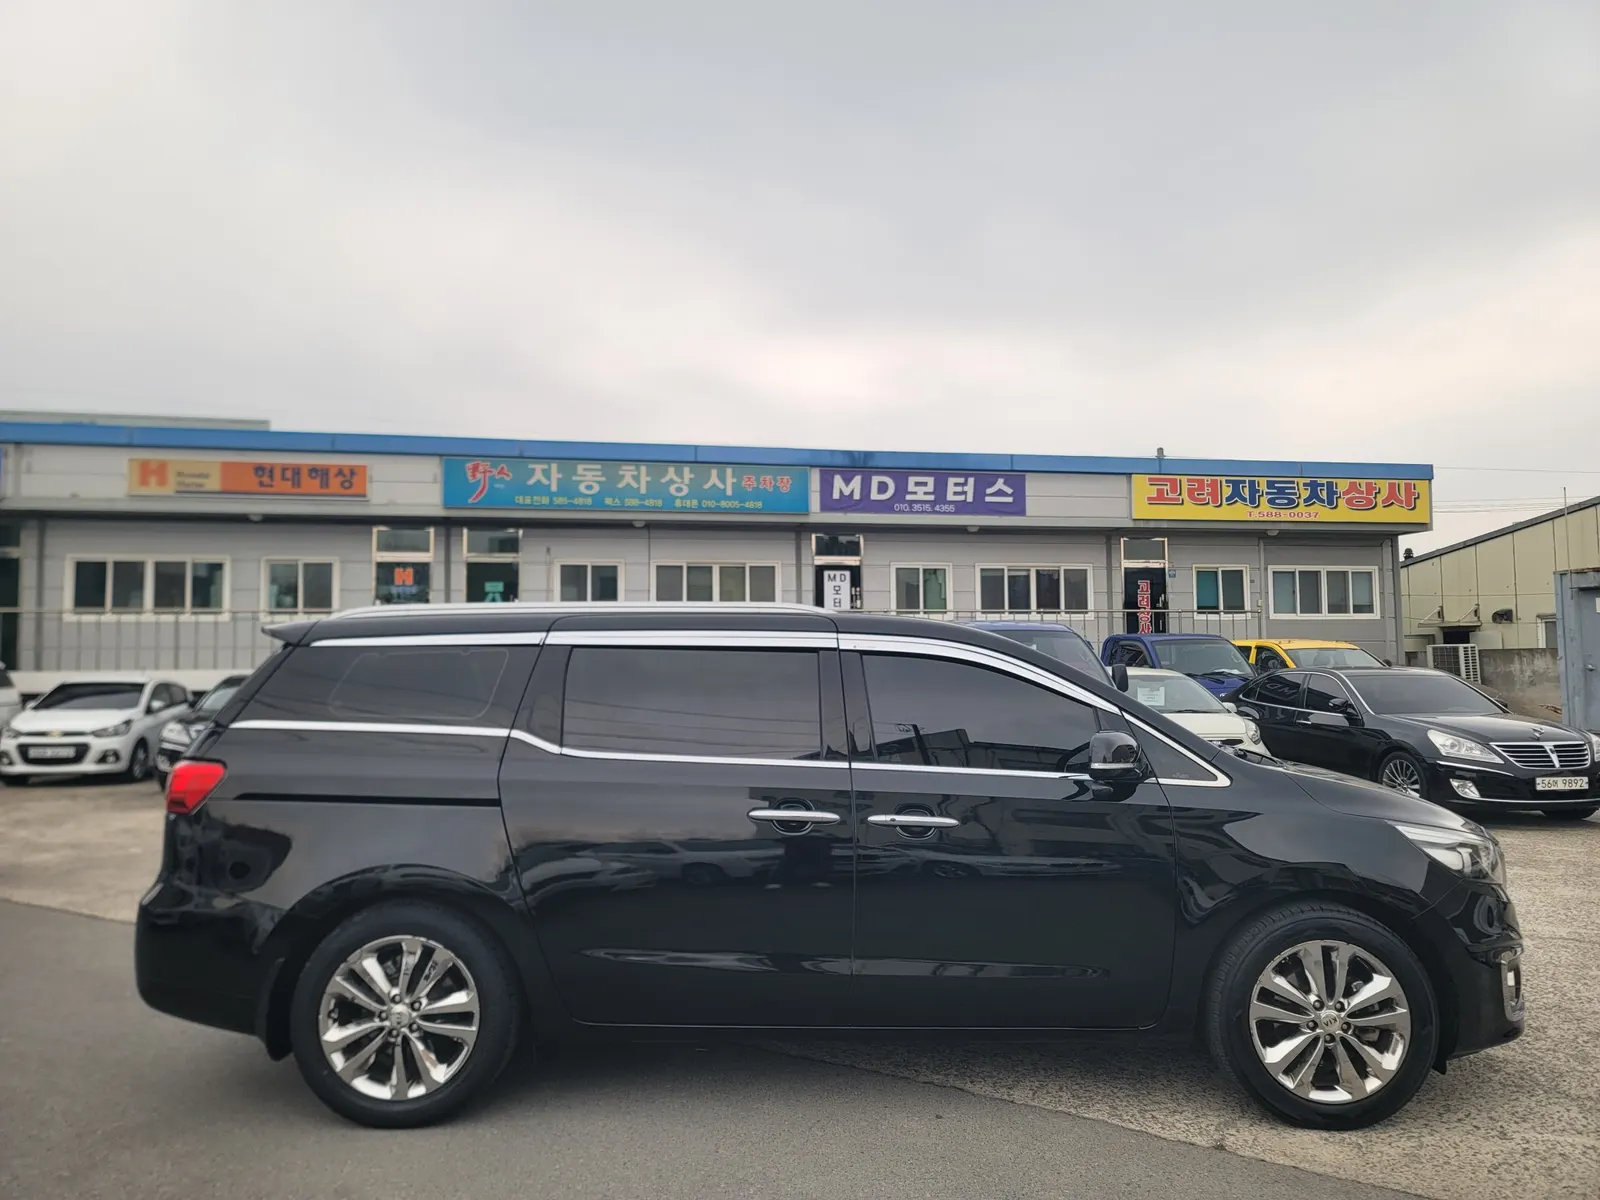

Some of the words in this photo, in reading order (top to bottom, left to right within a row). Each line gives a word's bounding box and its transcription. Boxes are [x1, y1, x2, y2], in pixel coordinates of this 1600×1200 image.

[253, 464, 357, 490] 현대해상
[526, 462, 737, 497] 자동차상사
[741, 475, 793, 494] 주차장
[832, 473, 895, 501] MD
[905, 475, 1014, 503] 모터스
[1146, 476, 1420, 511] 고려자동차상사
[1562, 778, 1584, 788] 9892
[1323, 1016, 1337, 1027] KIA
